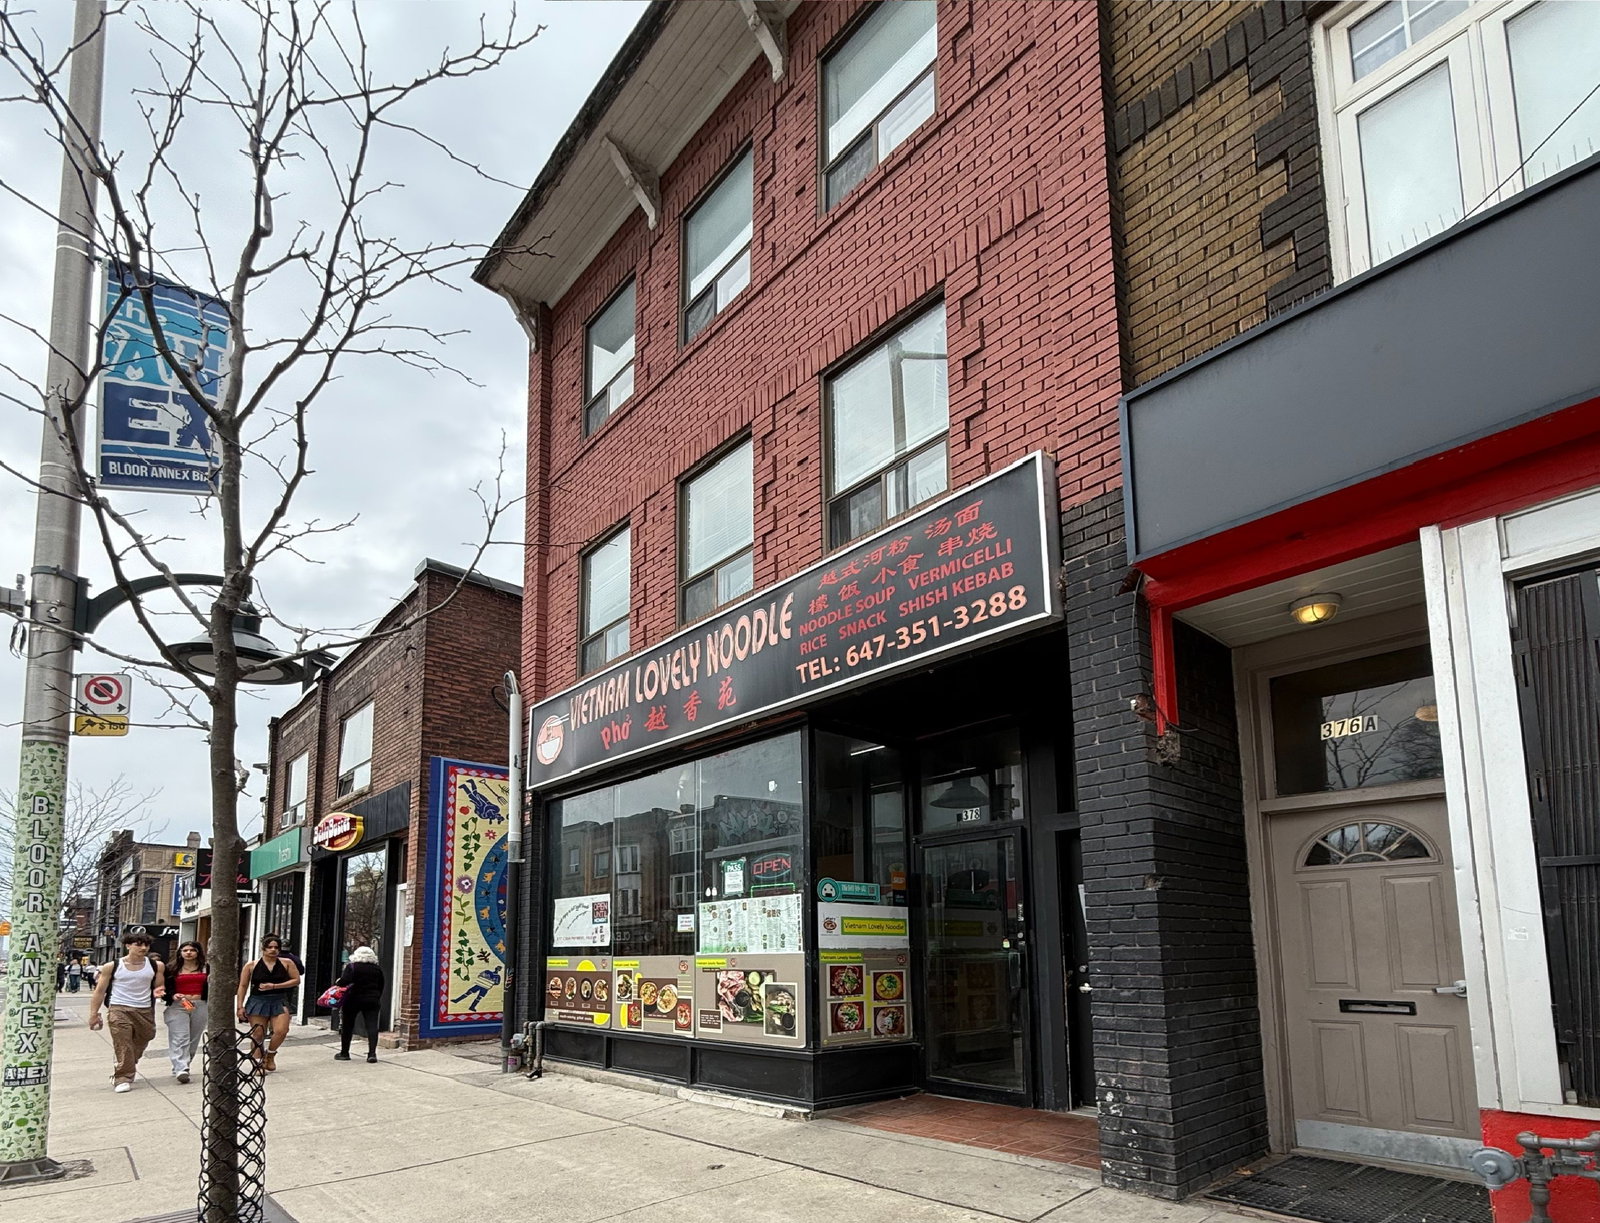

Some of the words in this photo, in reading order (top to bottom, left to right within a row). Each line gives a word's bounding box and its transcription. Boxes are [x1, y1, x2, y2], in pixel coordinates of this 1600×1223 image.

[108, 460, 148, 478] BLOOR
[151, 465, 190, 481] ANNEX
[818, 535, 912, 590] 越式河粉
[924, 499, 984, 540] 汤面
[871, 553, 924, 585] 小食
[937, 521, 999, 557] 串烧
[799, 604, 853, 637] NOODLE
[855, 585, 896, 614] SOUP
[908, 537, 1012, 592] VERMICELLI
[799, 633, 828, 656] RICE
[838, 610, 888, 640] SNACK
[898, 585, 948, 617] SHISH
[952, 561, 1015, 597] KEBAB
[570, 670, 630, 732] VIETNAM
[635, 640, 701, 704] LOVELY
[706, 592, 795, 677] NOODLE
[795, 656, 841, 684] TEL:
[845, 584, 1028, 668] 647-351-3288
[1321, 718, 1377, 739] 376A
[963, 808, 980, 821] 378
[27, 794, 50, 913] BLOOR
[727, 863, 741, 872] PASS
[753, 857, 792, 875] OPEN
[845, 922, 867, 930] Vietnam
[868, 923, 884, 931] Lovely
[19, 931, 42, 1054] ANNEX
